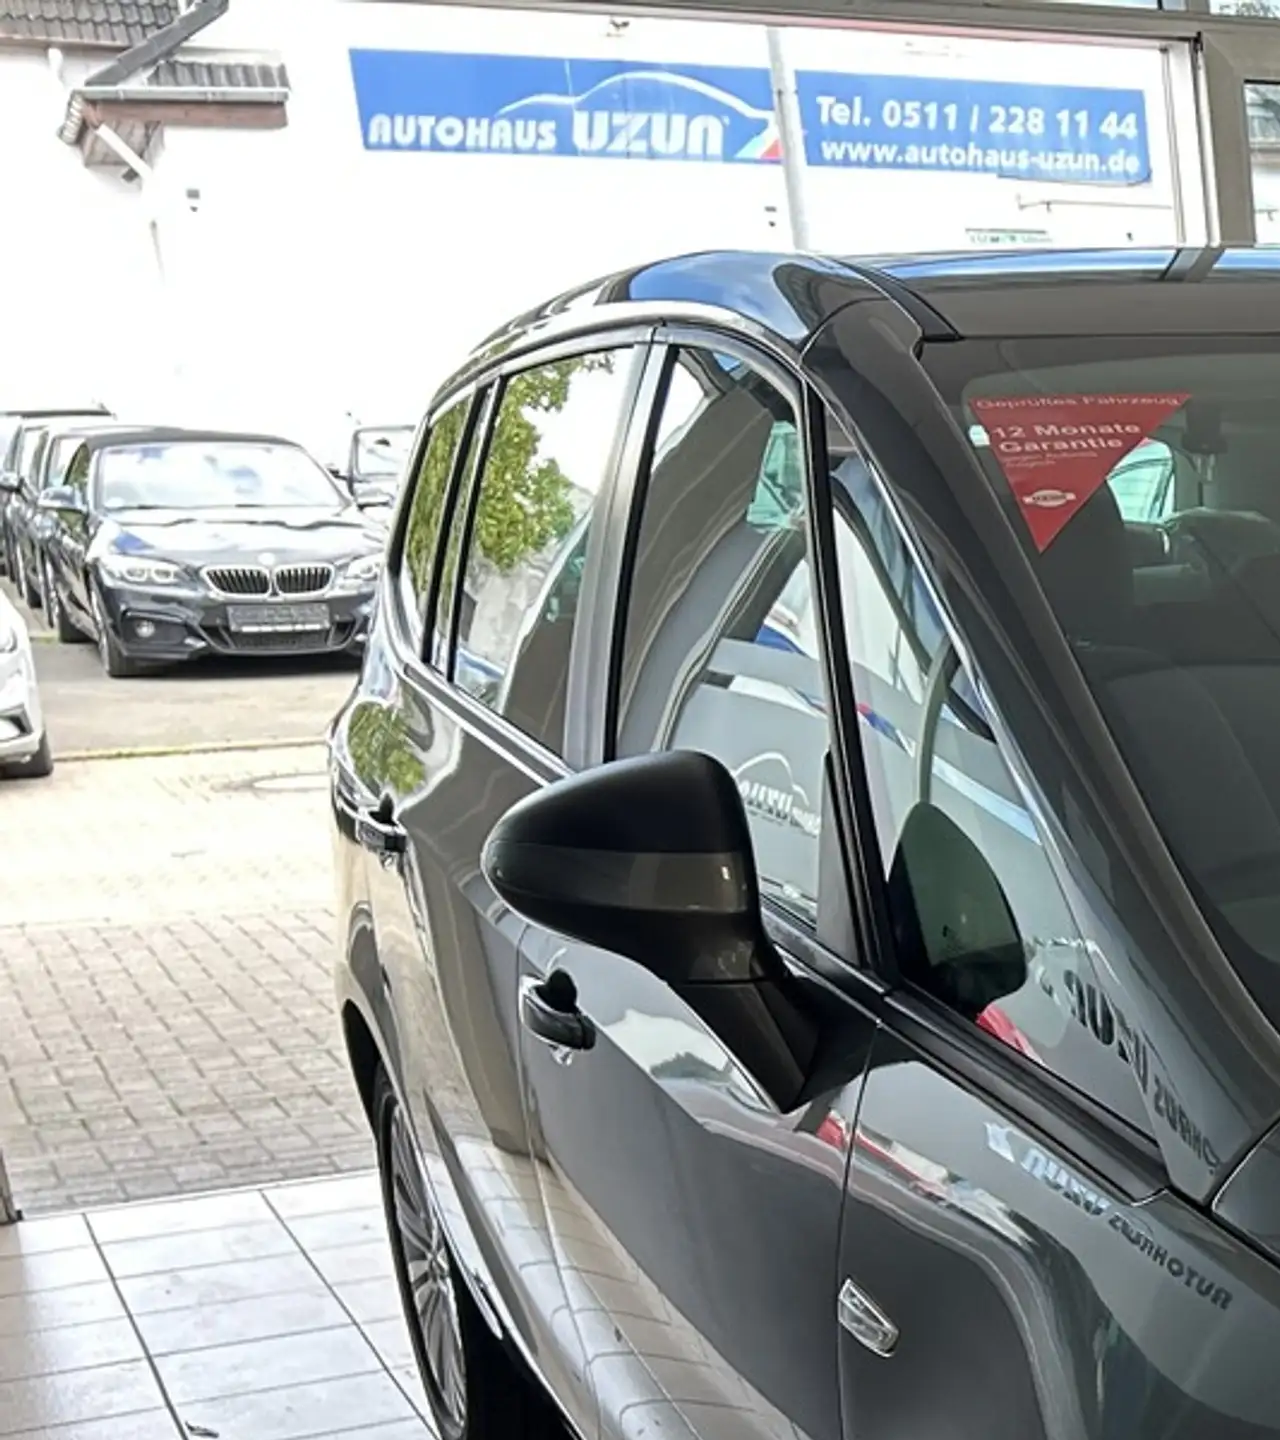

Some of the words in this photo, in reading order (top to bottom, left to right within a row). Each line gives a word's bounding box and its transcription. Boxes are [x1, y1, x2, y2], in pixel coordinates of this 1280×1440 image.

[368, 113, 556, 150] AUTOHAUS
[571, 110, 725, 157] UZUN
[816, 96, 871, 127] Tel.
[882, 100, 959, 131] 0511
[988, 105, 1046, 136] 228
[1056, 109, 1089, 138] 11
[1099, 112, 1138, 139] 44
[821, 140, 1140, 174] www.autohaus-uzun.de
[992, 425, 1026, 439] 12
[1034, 423, 1141, 438] Monate
[999, 437, 1124, 454] Garantie
